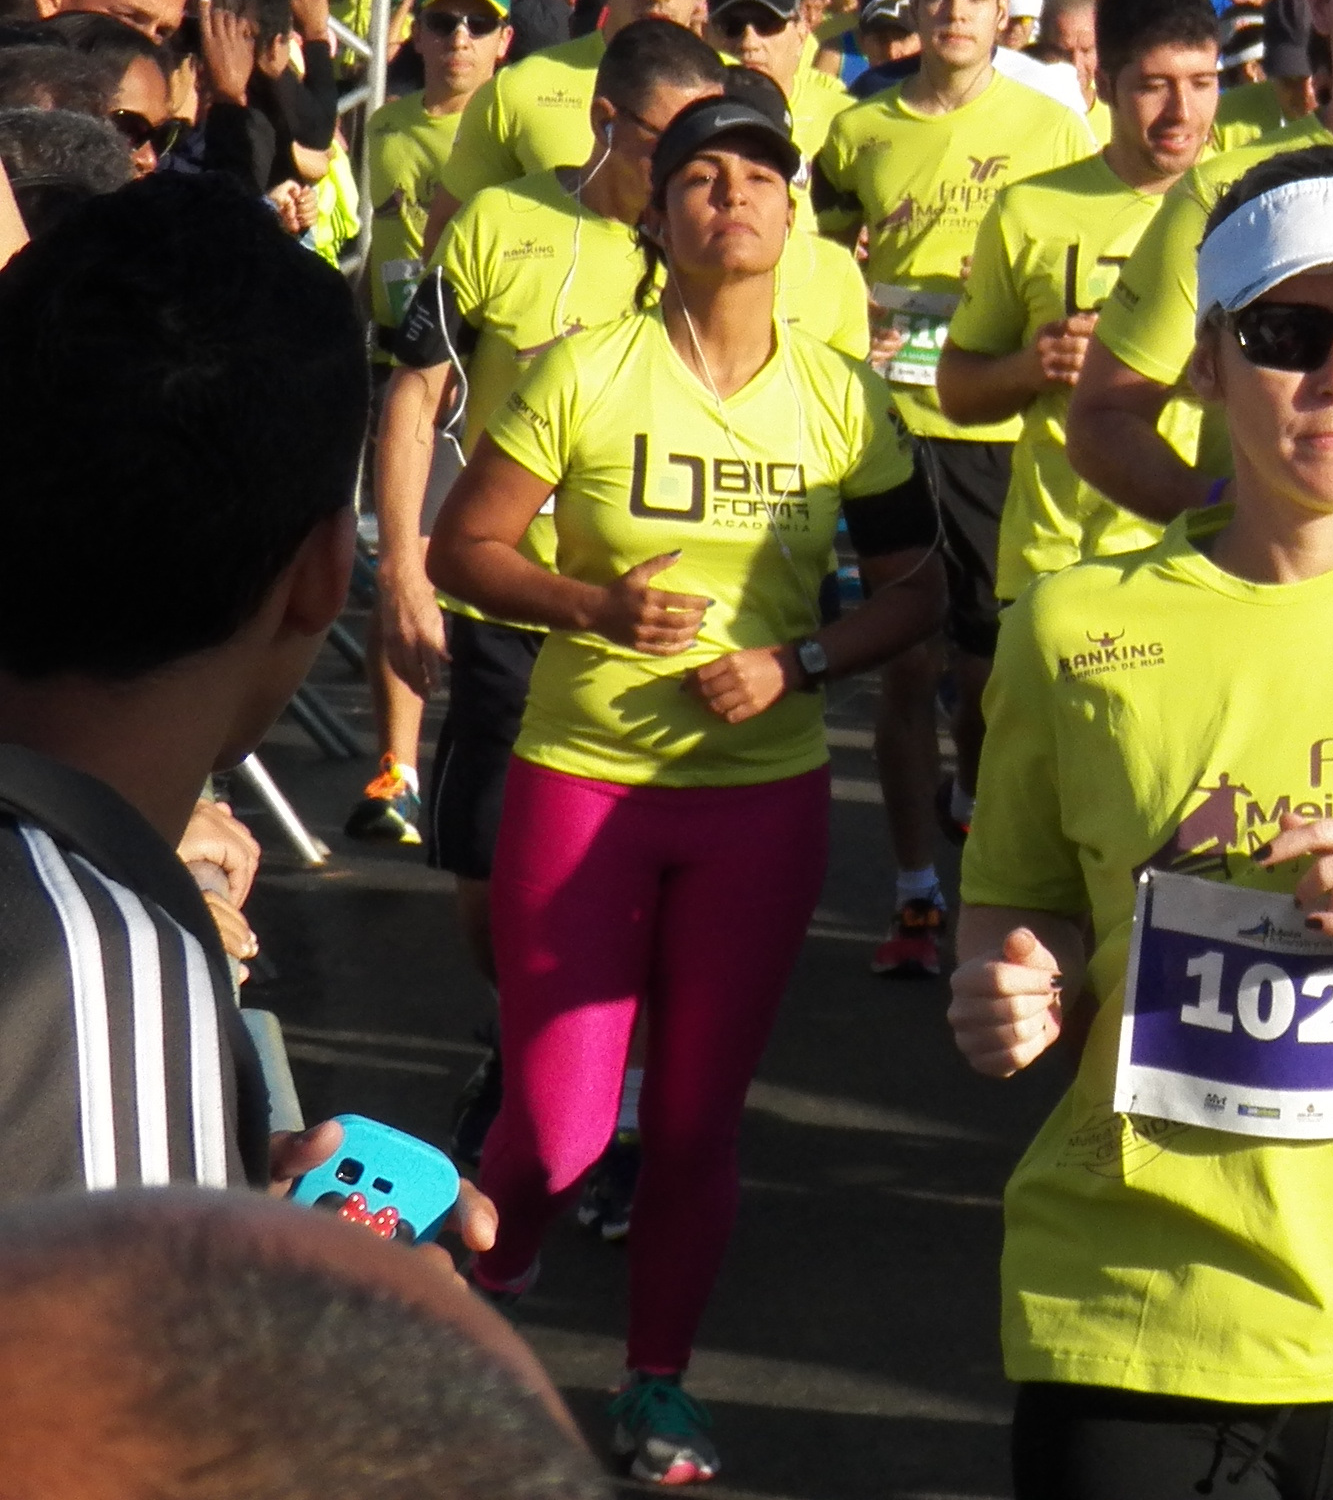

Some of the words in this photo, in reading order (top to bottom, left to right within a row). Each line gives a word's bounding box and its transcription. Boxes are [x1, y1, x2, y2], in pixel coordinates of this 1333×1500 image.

[712, 457, 808, 499] BIO
[712, 498, 810, 521] FORMA
[1058, 642, 1164, 673] RANKING
[1121, 661, 1136, 671] DE
